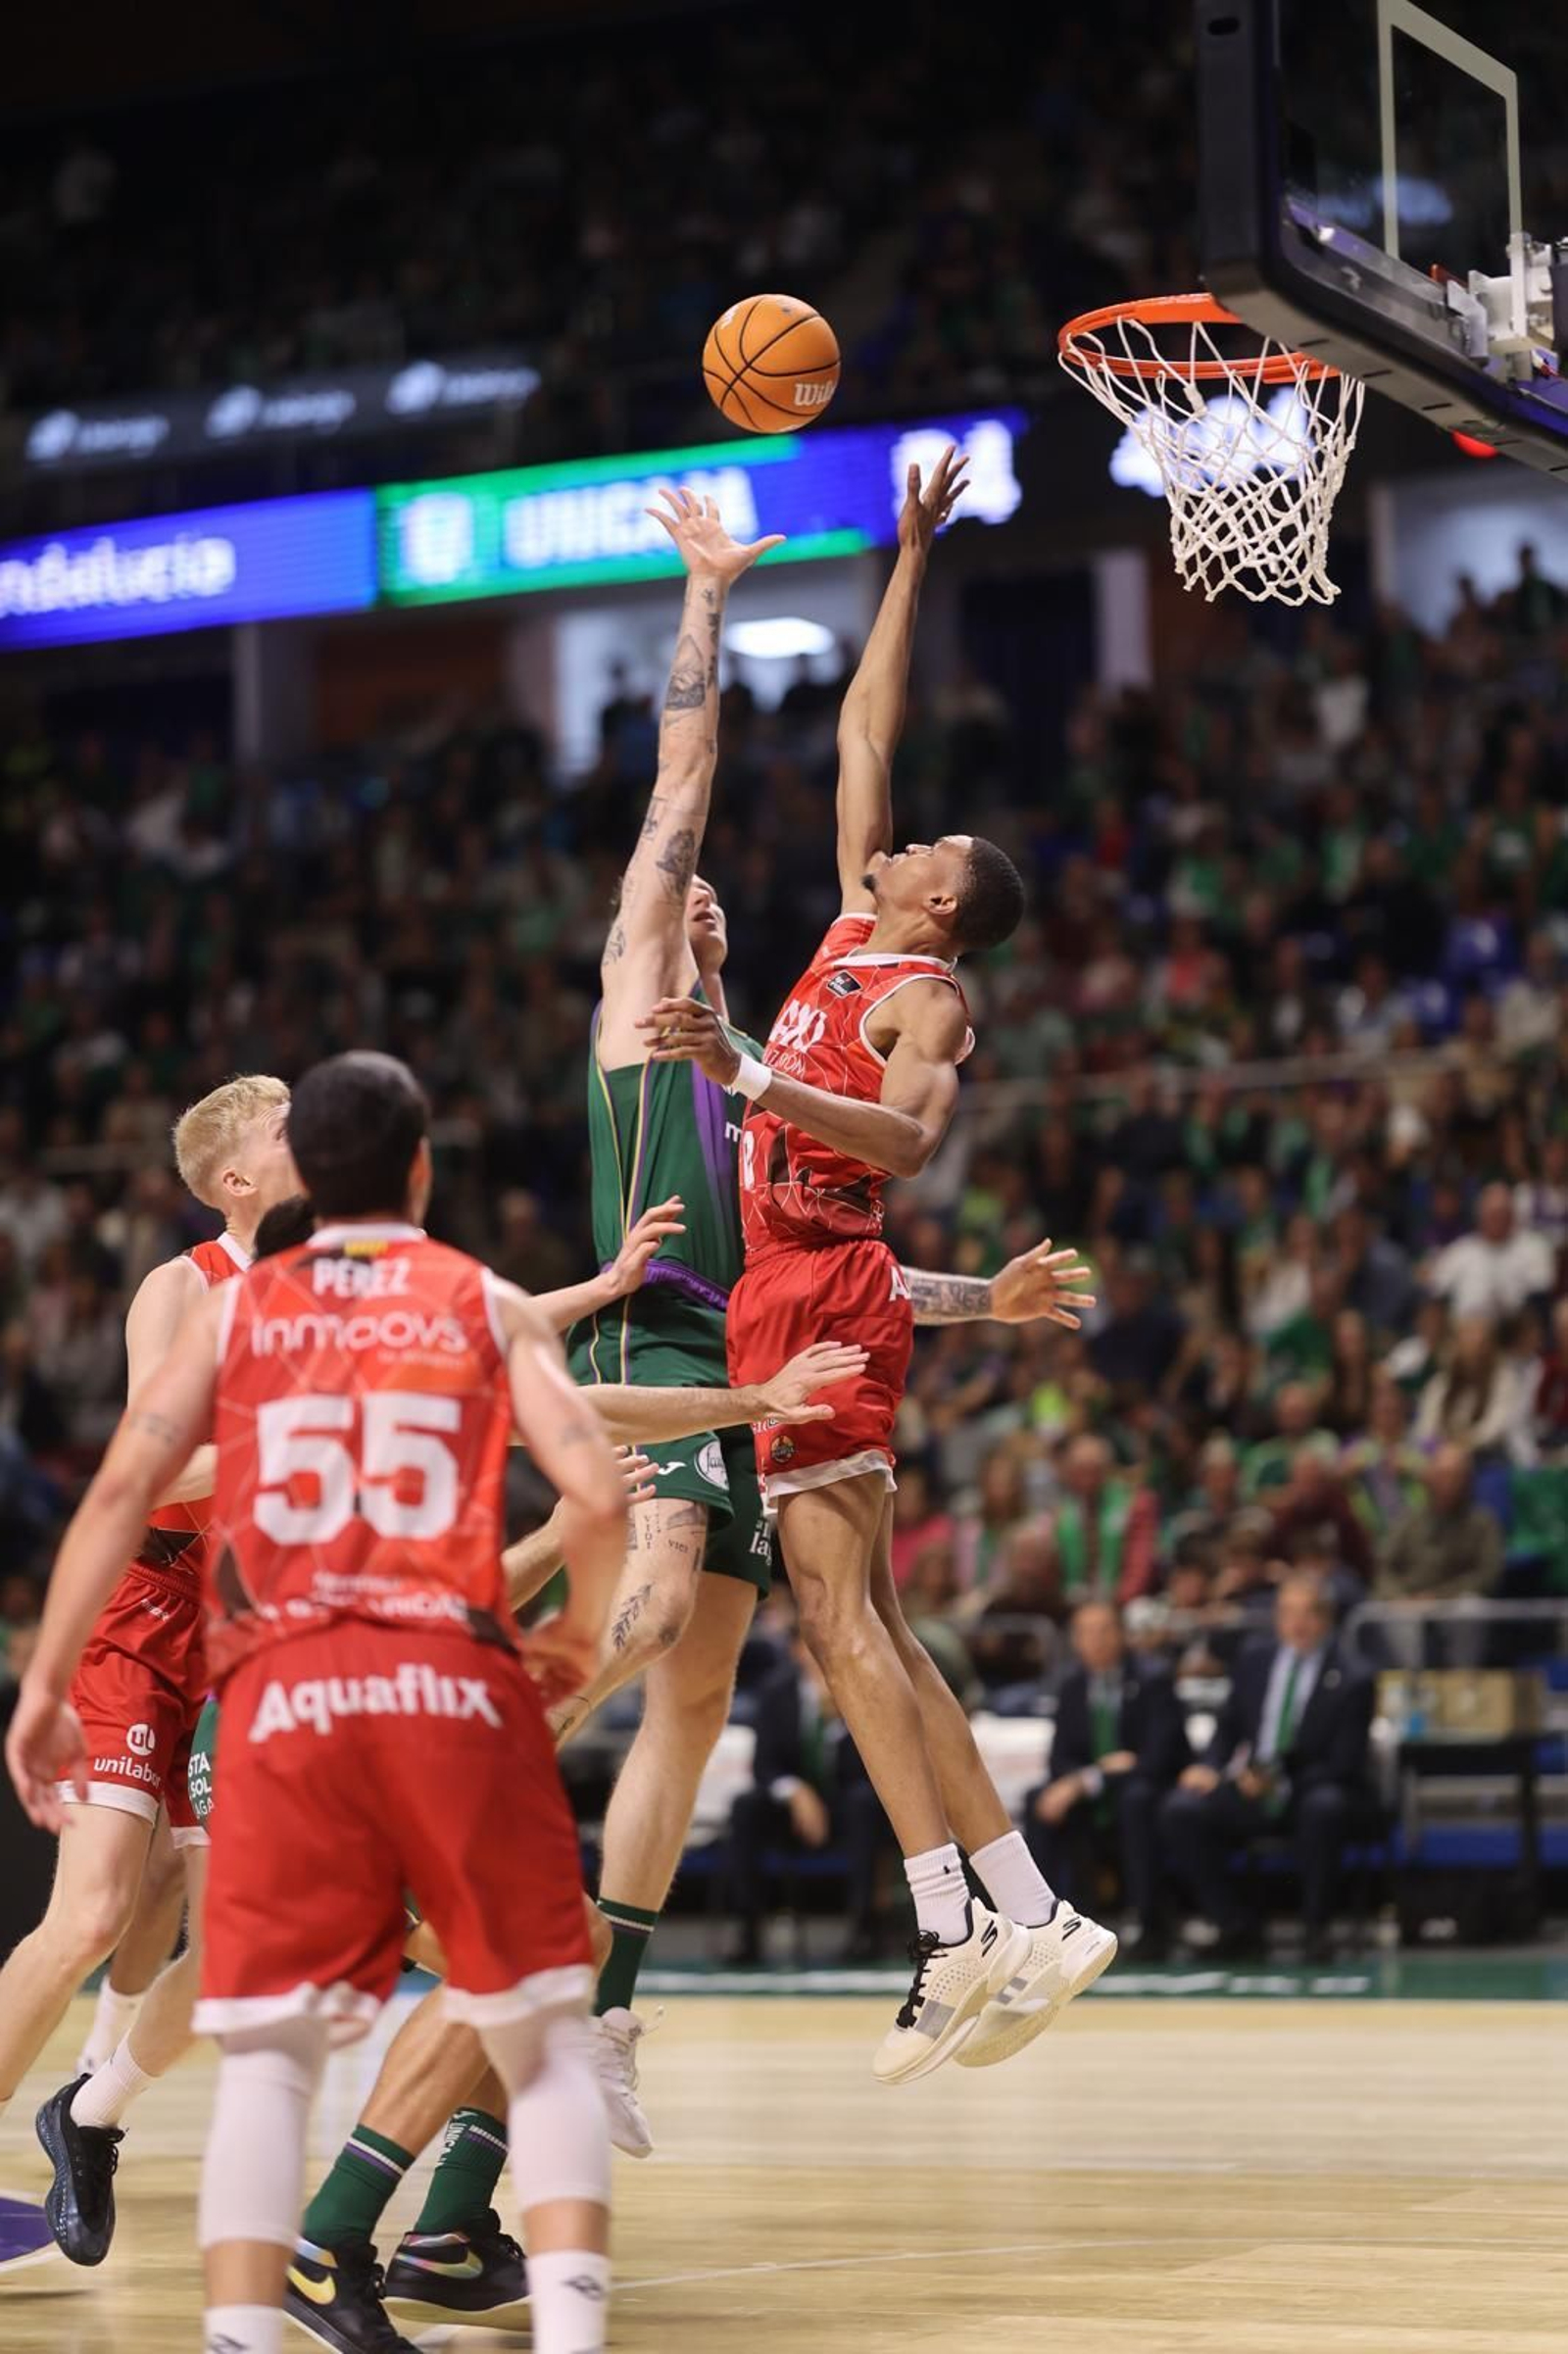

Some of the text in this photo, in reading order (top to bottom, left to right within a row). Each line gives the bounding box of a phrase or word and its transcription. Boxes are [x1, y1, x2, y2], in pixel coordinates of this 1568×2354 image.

[794, 380, 835, 406] Wil
[254, 1392, 463, 1545] 55
[248, 1663, 504, 1743] Aquaflix
